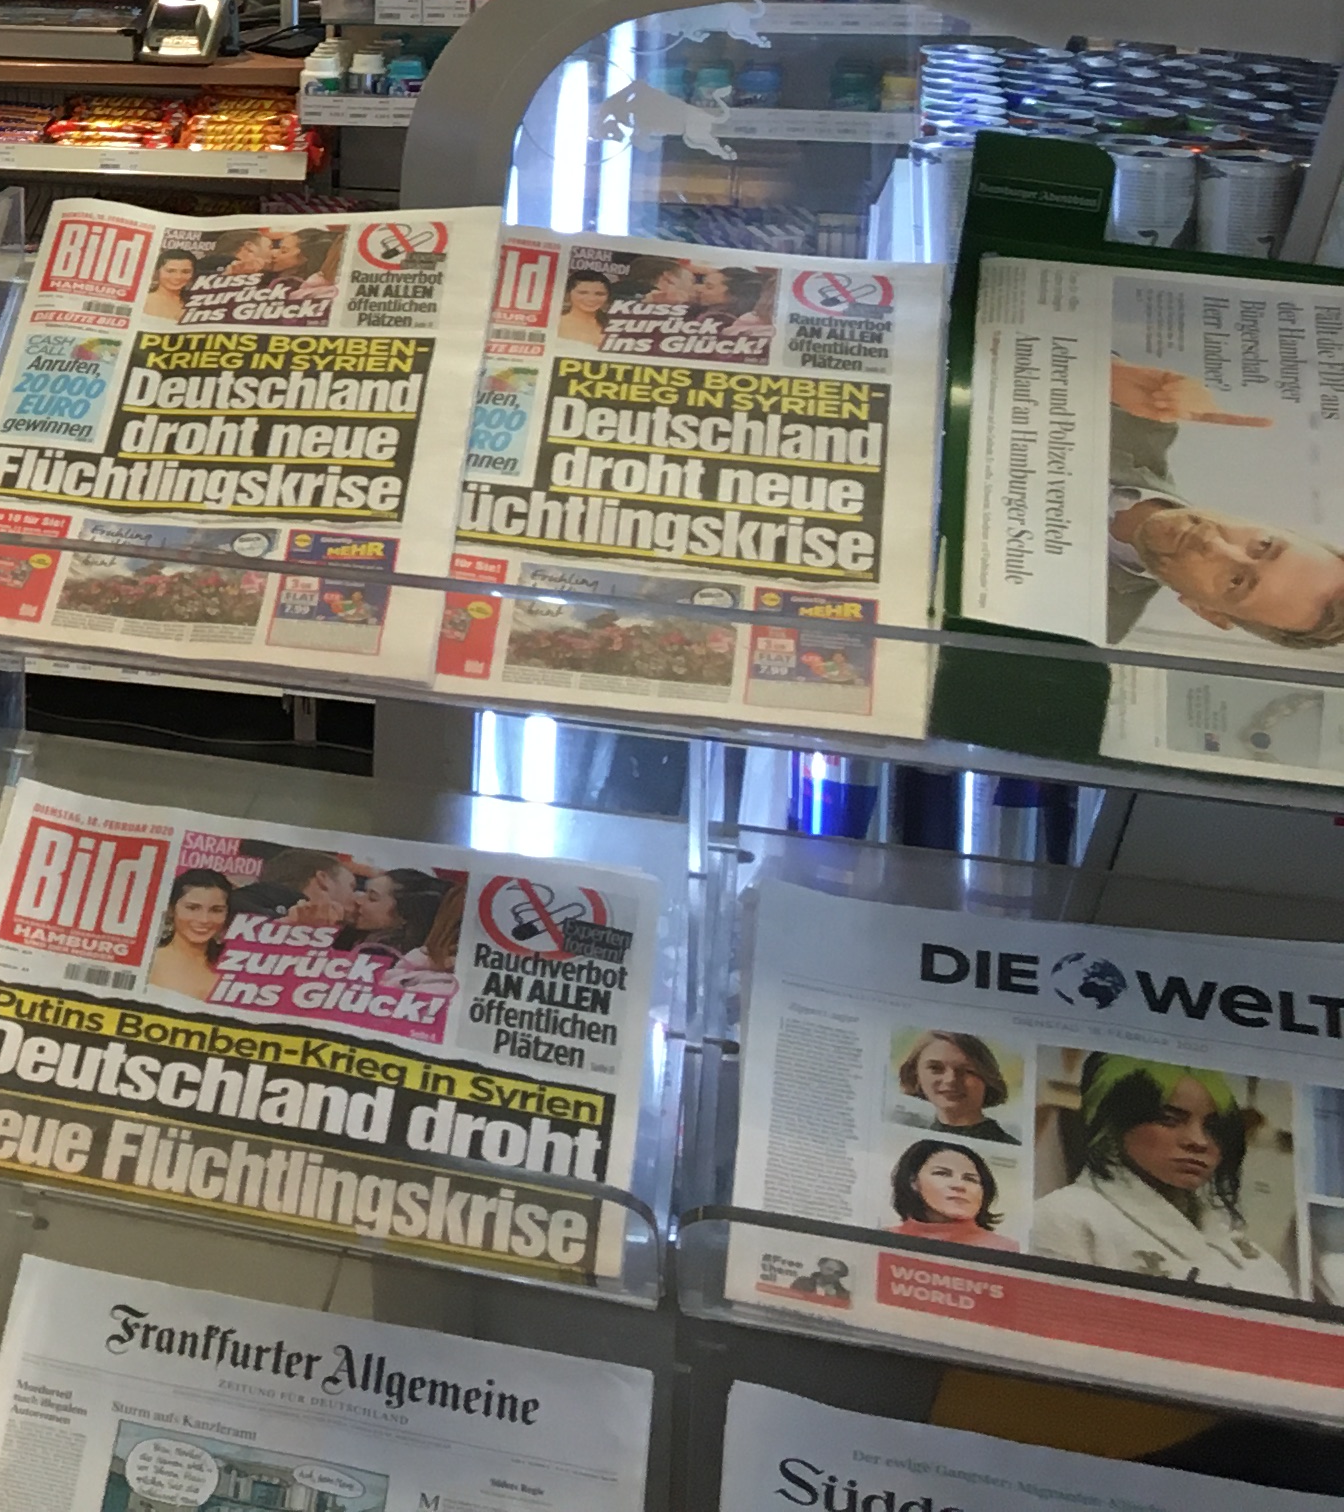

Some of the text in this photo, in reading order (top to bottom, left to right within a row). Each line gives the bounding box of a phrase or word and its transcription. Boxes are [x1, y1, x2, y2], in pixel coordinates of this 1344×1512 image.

[165, 229, 202, 241] SARAH
[53, 222, 146, 286] Bild
[569, 260, 631, 276] LOMBARDI
[572, 247, 612, 263] SARAH
[49, 281, 127, 297] HAMBURG
[191, 273, 262, 291] Kuss
[350, 270, 444, 285] Rauchverbot
[355, 284, 432, 299] AN ALLEN
[181, 298, 330, 323] ins Glück!
[187, 285, 288, 307] zurück
[347, 299, 437, 314] öffentlichen
[609, 299, 689, 319] Kuss
[357, 312, 412, 328] Plätzen
[605, 316, 723, 336] zurück
[788, 313, 893, 333] Rauchverbot
[24, 344, 67, 357] CALL
[28, 334, 76, 348] CASH
[139, 333, 429, 355] PUTINS BOMBEN-
[599, 333, 770, 356] ins Glück!
[1202, 296, 1232, 393] Herr Lindner?
[1239, 298, 1269, 388] Bürgerschaft,
[1275, 301, 1302, 403] der Hamburger
[26, 354, 101, 378] Anrufen,
[146, 353, 414, 373] KRIEG IN SYRIEN
[1314, 304, 1343, 421] Fällt die FDP aus
[123, 366, 424, 413] Deutschland
[558, 360, 888, 401] PUTINS BOMBEN-
[15, 393, 92, 418] EURO
[567, 380, 870, 421] KRIEG IN SYRIEN
[0, 416, 93, 439] gewinnen
[119, 417, 399, 461] droht neue
[549, 394, 885, 467] Deutschland
[1002, 329, 1041, 586] Amoklauf an Hamburger Schule
[1044, 333, 1078, 557] Lehrer und Polizei vereiteln
[551, 446, 866, 514] droht neue
[457, 482, 877, 572] üchtlingskrise
[799, 601, 864, 620] MEHR
[33, 803, 175, 837] DIENSTAG, FEBRUAR 2020
[184, 831, 241, 854] SARAH
[179, 849, 263, 876] LOMBARDI
[18, 824, 160, 938] Bild
[14, 924, 129, 957] HAMBURG
[224, 914, 338, 947] Kuss
[565, 920, 631, 950] Experten
[217, 944, 385, 985] zurück
[472, 942, 628, 991] Rauchverbot
[920, 942, 1041, 996] DIE
[212, 972, 447, 1025] ins Glück!
[482, 973, 612, 1016] AN ALLEN
[468, 996, 618, 1046] öffentlichen
[492, 1029, 587, 1070] Plätzen
[116, 1009, 409, 1090] Bomben-Krieg
[420, 1064, 456, 1093] in
[466, 1075, 600, 1125] Syrien
[406, 1097, 602, 1184] droht
[103, 1112, 590, 1267] Flüchtlingskrise
[760, 1271, 779, 1283] all
[761, 1263, 797, 1283] them
[889, 1264, 1005, 1300] WOMEN'S
[890, 1282, 976, 1310] WORLD
[105, 1302, 540, 1426] Frankfurter Allgemeine
[14, 1392, 38, 1407] nach
[217, 1377, 410, 1425] ZEITUNG FÜR DEUTSCHLAND
[111, 1401, 257, 1441] Sturm aufs Kanzleramt
